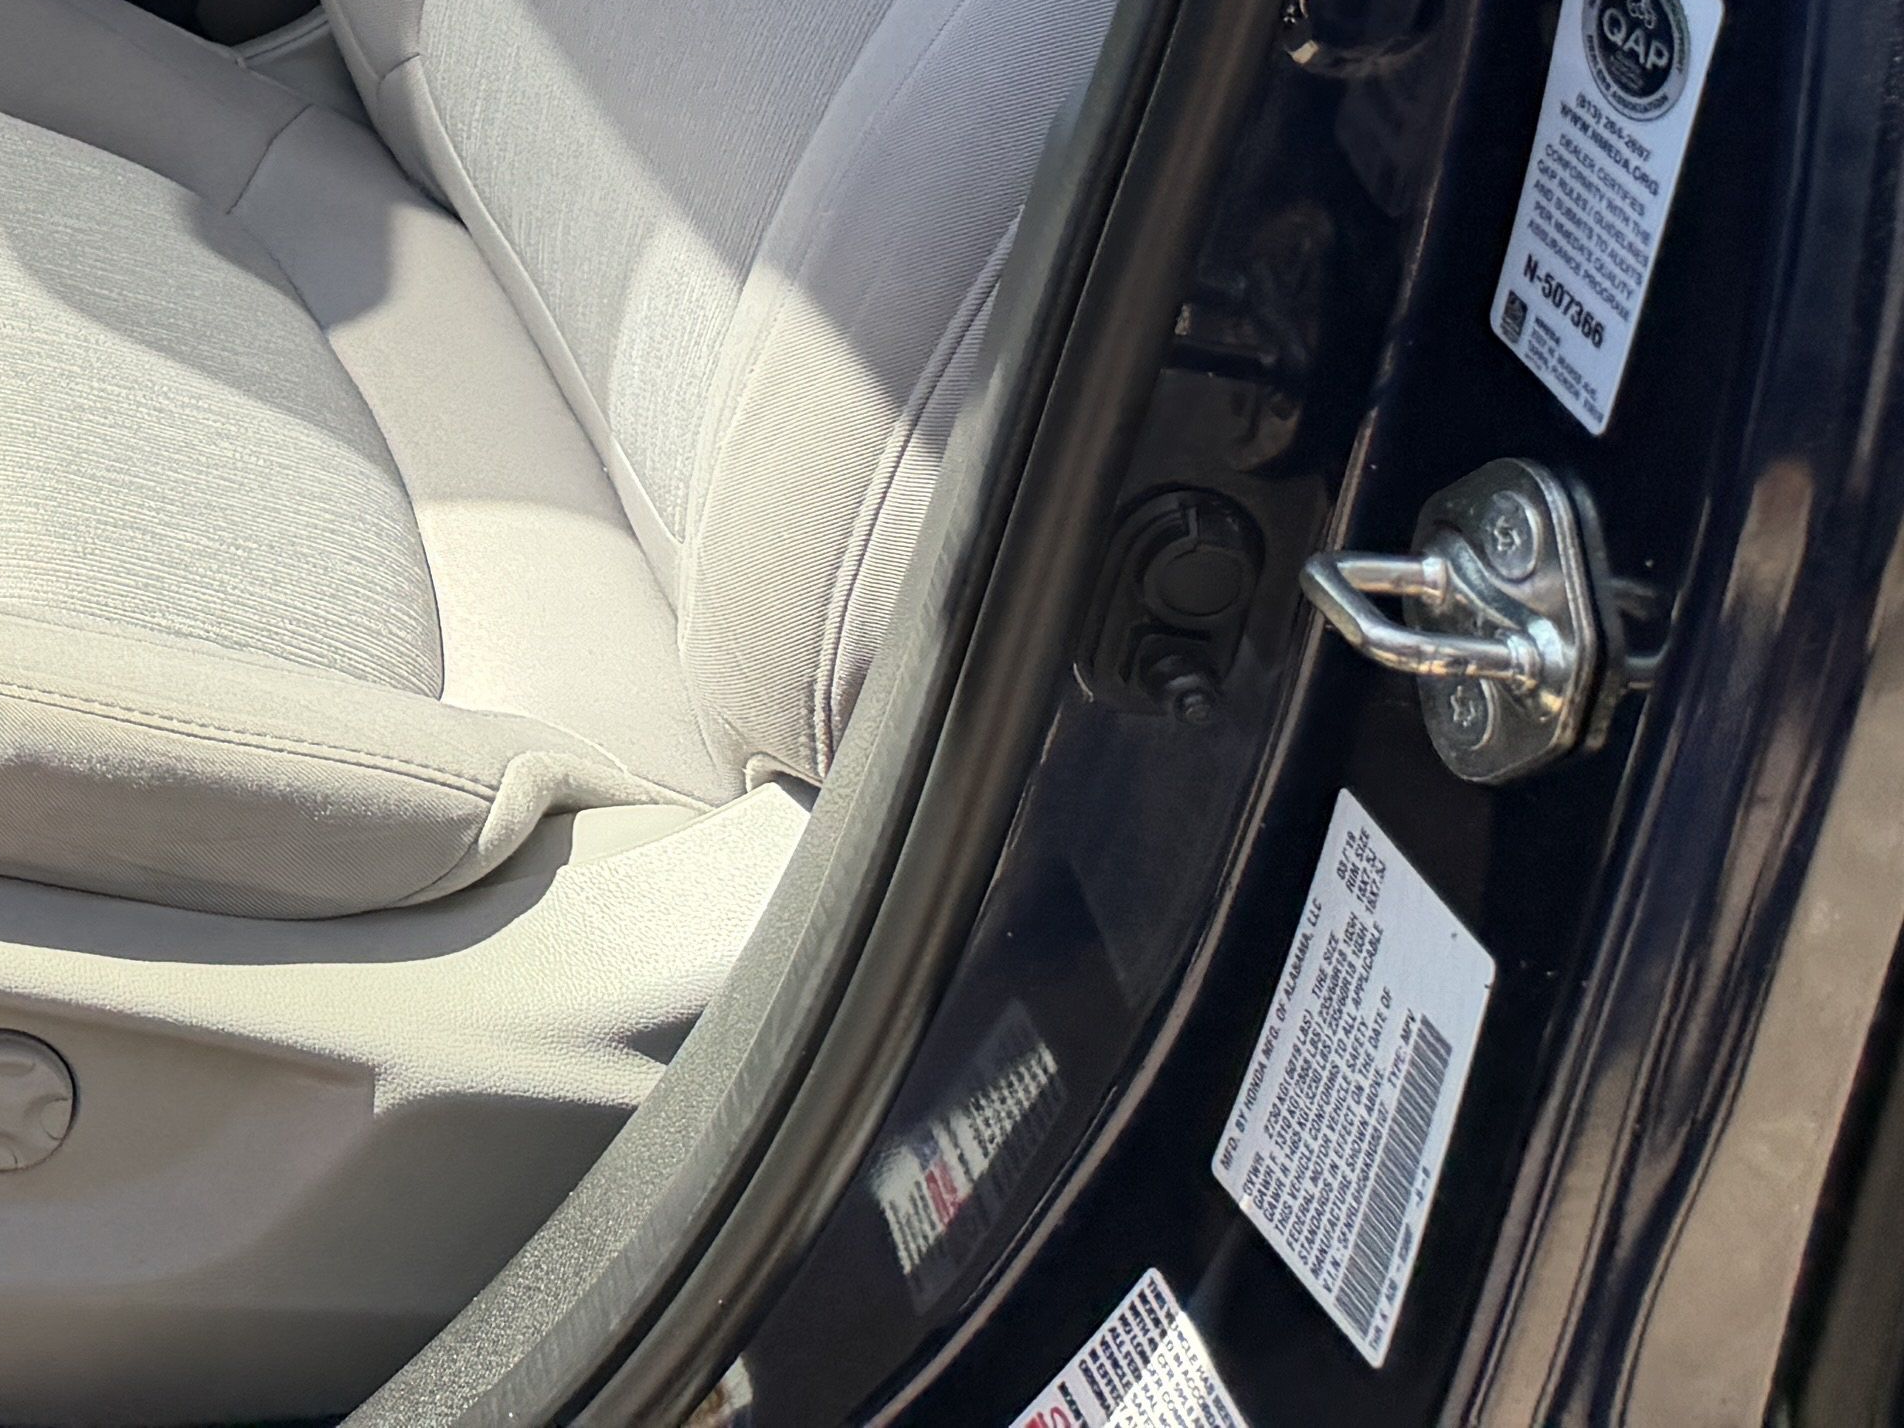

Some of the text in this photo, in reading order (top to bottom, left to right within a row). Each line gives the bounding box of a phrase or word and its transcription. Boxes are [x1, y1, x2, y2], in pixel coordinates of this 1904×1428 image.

[1603, 8, 1667, 68] QAP
[1524, 255, 1604, 347] N-507366
[1354, 826, 1370, 861] SIZE
[1311, 965, 1328, 999] TIRE
[1322, 930, 1339, 965] SIZE
[1234, 1108, 1247, 1133] BY
[1243, 1061, 1267, 1110] HONDA
[1275, 999, 1286, 1022] OF
[1306, 897, 1322, 927] LLC
[1400, 1008, 1416, 1045] MPV
[1273, 921, 1383, 1235] THIS VEHICLE CONFORMS TO ALL APPLICABLE
[1285, 1015, 1368, 1251] FEDERAL MOTOR VEHICLE SAFETY
[1298, 986, 1392, 1265] STANDARDS IN EFFECT ON THE DATE OF
[1252, 1164, 1275, 1210] GAWR
[1263, 1177, 1285, 1222] GAWR
[1310, 1171, 1351, 1279] MANUFACTURE
[1345, 1114, 1369, 1172] SHOWN
